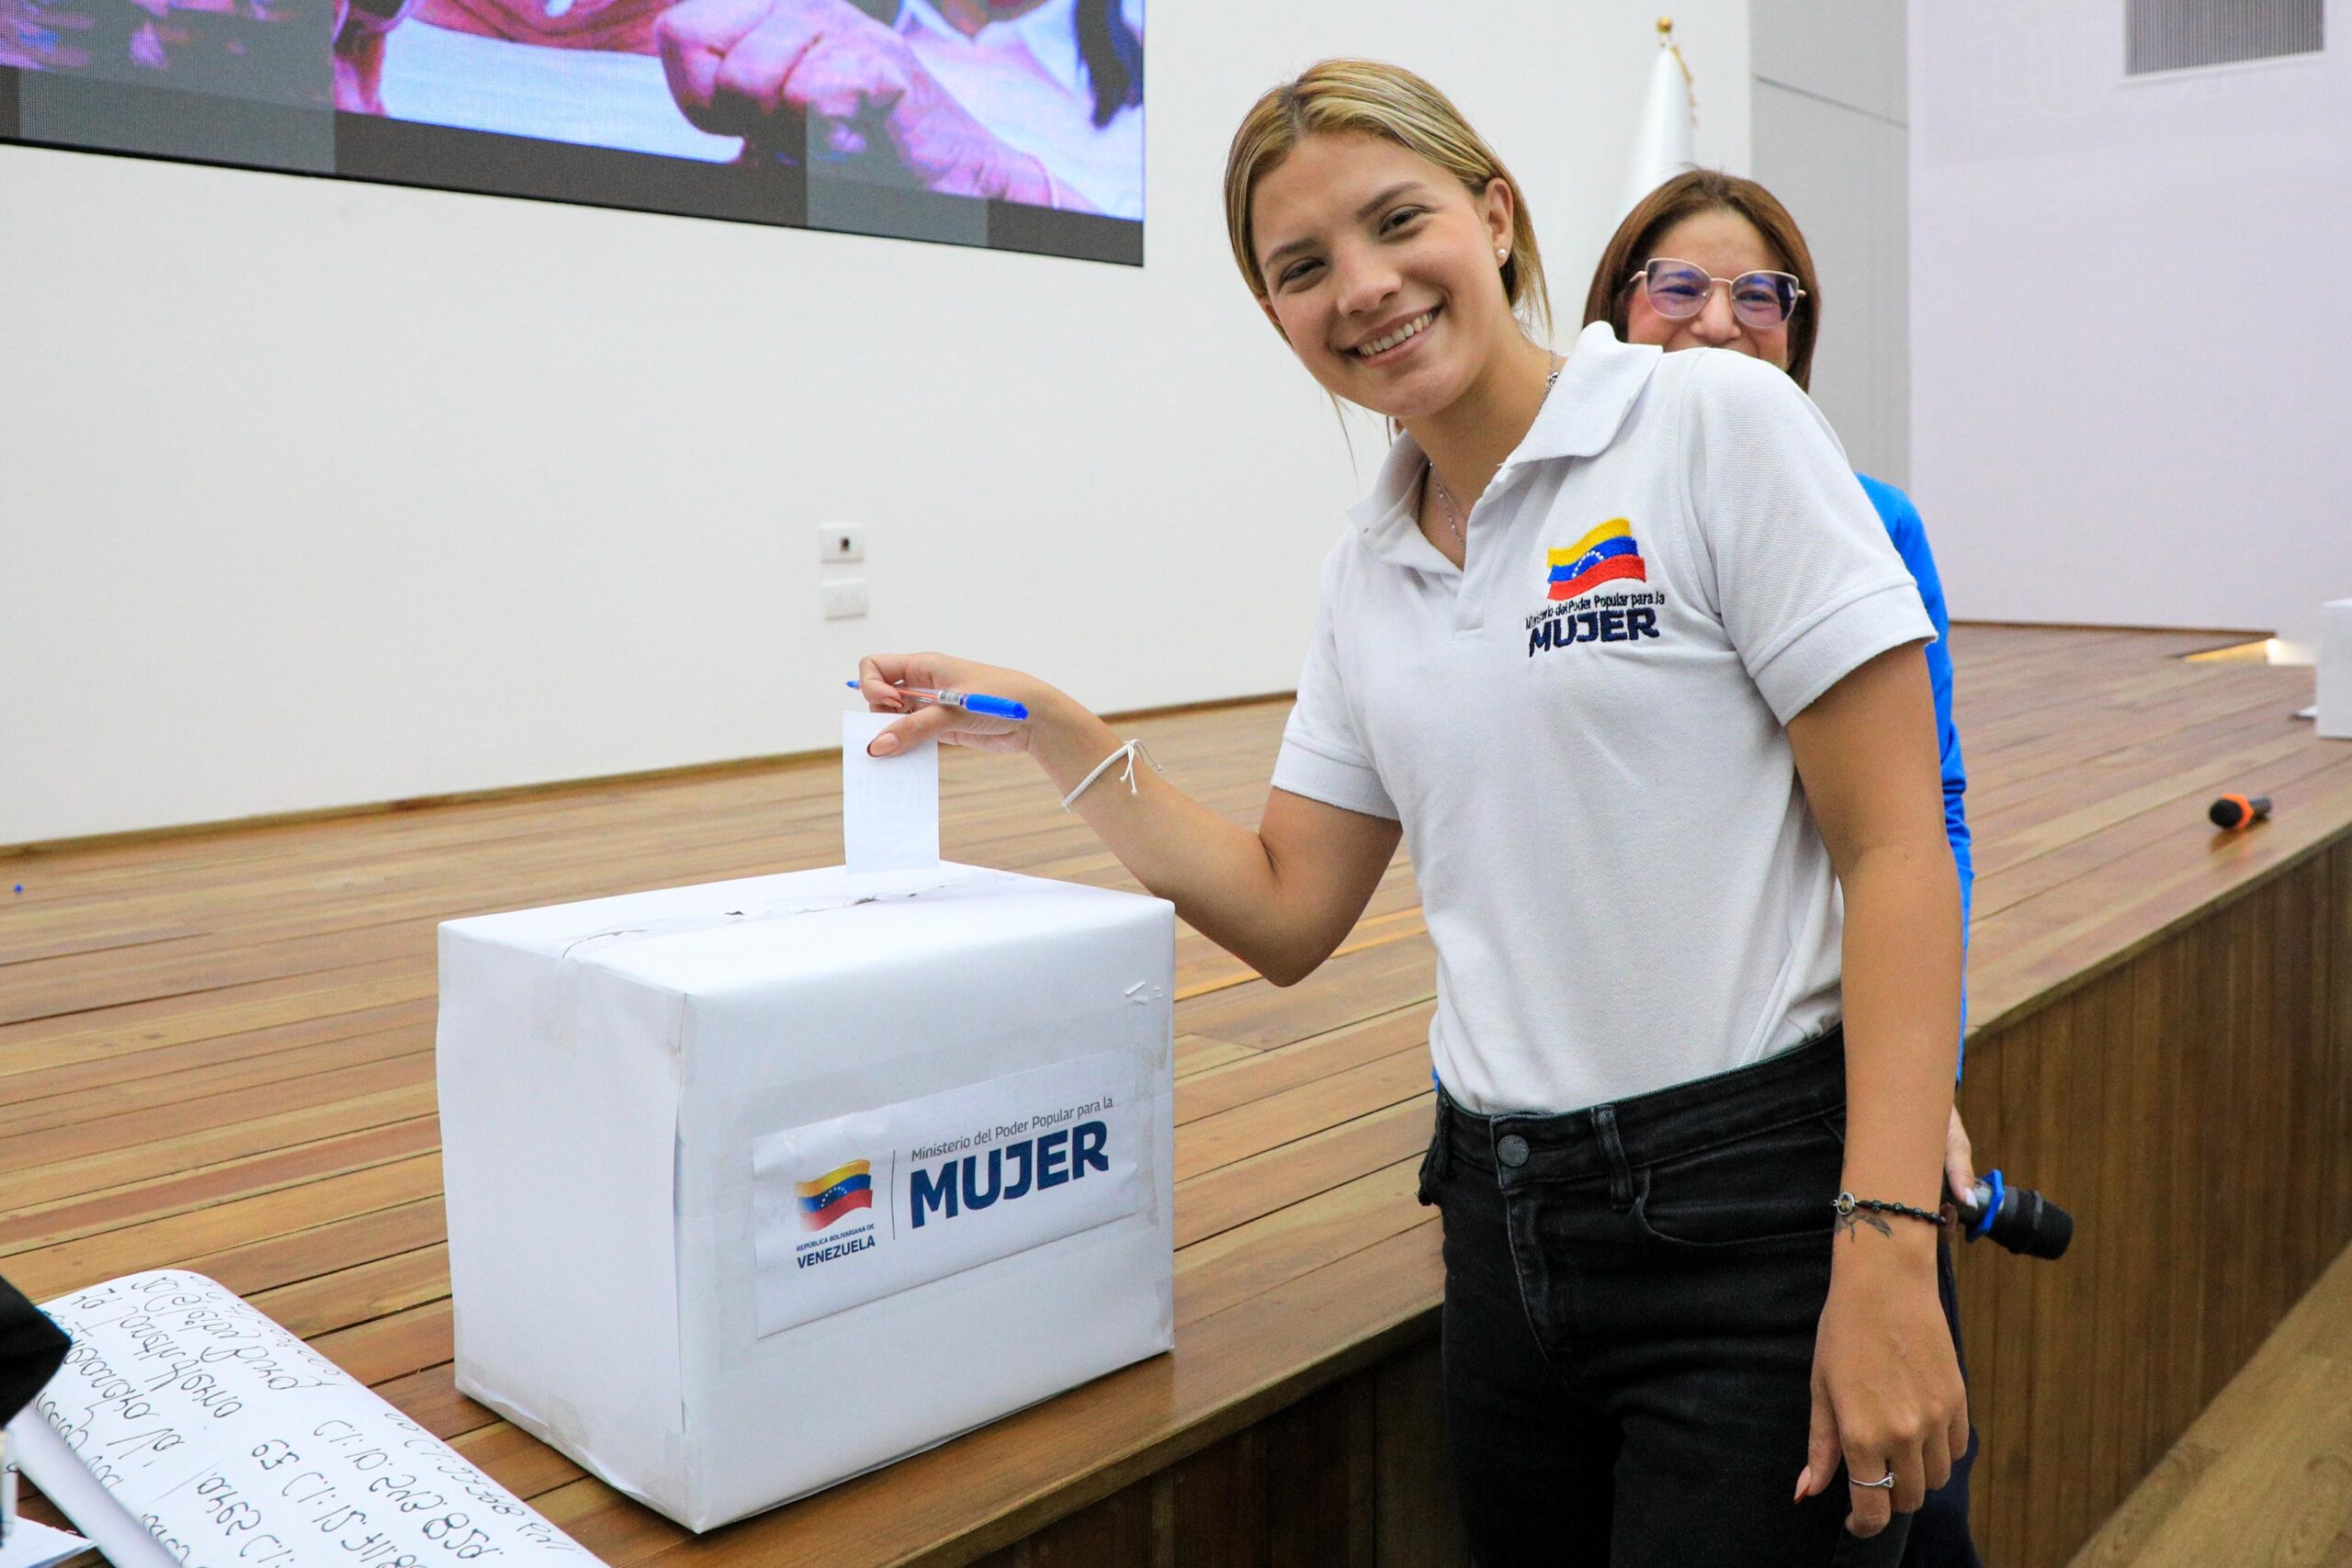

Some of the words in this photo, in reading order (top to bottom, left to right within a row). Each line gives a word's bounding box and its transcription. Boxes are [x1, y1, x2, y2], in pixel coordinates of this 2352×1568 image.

[1555, 600, 1567, 616] del
[1568, 597, 1591, 614] Poder
[1594, 592, 1629, 609] Popular
[1631, 593, 1653, 608] para
[1655, 592, 1665, 605] la
[1529, 607, 1660, 659] MUJER
[911, 1136, 970, 1161] Ministerio
[974, 1130, 991, 1145] del
[996, 1121, 1029, 1139] Poder
[1032, 1109, 1074, 1129] Popular
[1077, 1101, 1101, 1120] para
[1103, 1096, 1114, 1109] la
[910, 1121, 1109, 1229] MUJER
[796, 1237, 829, 1252] REPÚBLICA
[829, 1225, 865, 1243] BOLIVARIANA
[866, 1224, 875, 1232] DE
[797, 1235, 876, 1269] VENEZUELA
